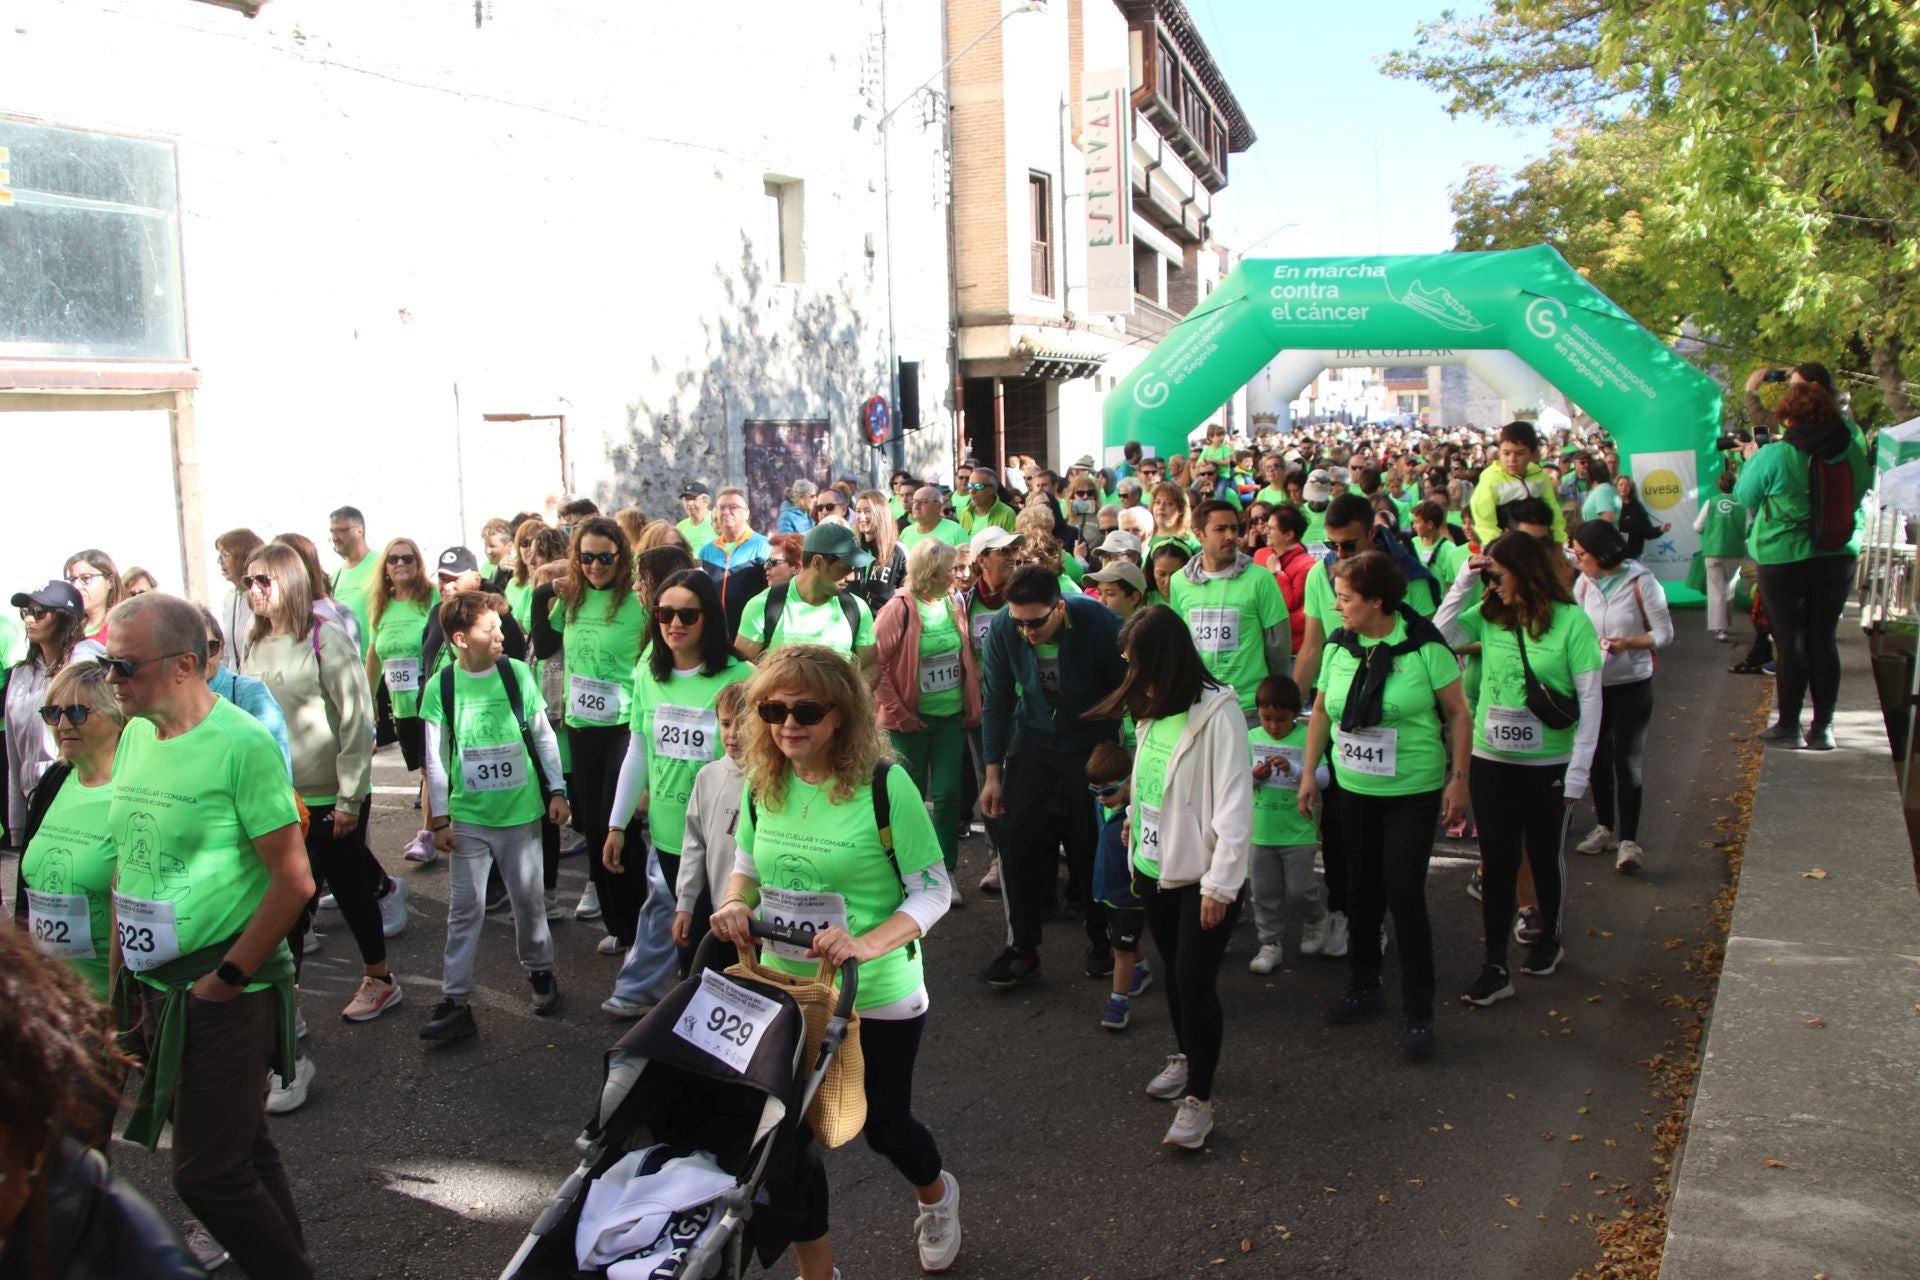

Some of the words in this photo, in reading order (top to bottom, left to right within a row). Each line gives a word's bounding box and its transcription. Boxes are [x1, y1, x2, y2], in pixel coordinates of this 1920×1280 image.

[1273, 265, 1299, 279] En
[1304, 264, 1386, 279] marcha
[1270, 281, 1339, 299] contra
[1271, 303, 1293, 321] el
[1295, 302, 1370, 321] cáncer
[1554, 342, 1569, 357] en
[1567, 352, 1605, 388] Segovia
[1562, 332, 1592, 360] contra
[1590, 357, 1603, 368] el
[1600, 364, 1632, 394] cáncer
[1571, 324, 1617, 365] asociación
[1616, 361, 1658, 399] española
[1644, 485, 1680, 496] uvesa
[1195, 626, 1232, 640] 2318
[390, 670, 410, 683] 395
[928, 665, 960, 684] 1116
[578, 693, 605, 711] 426
[661, 725, 705, 747] 2319
[1493, 724, 1533, 741] 1596
[1344, 743, 1384, 763] 2441
[477, 762, 513, 780] 319
[820, 837, 856, 848] COMARCA
[36, 917, 71, 943] 622
[119, 921, 155, 953] 623
[707, 1006, 754, 1047] 929
